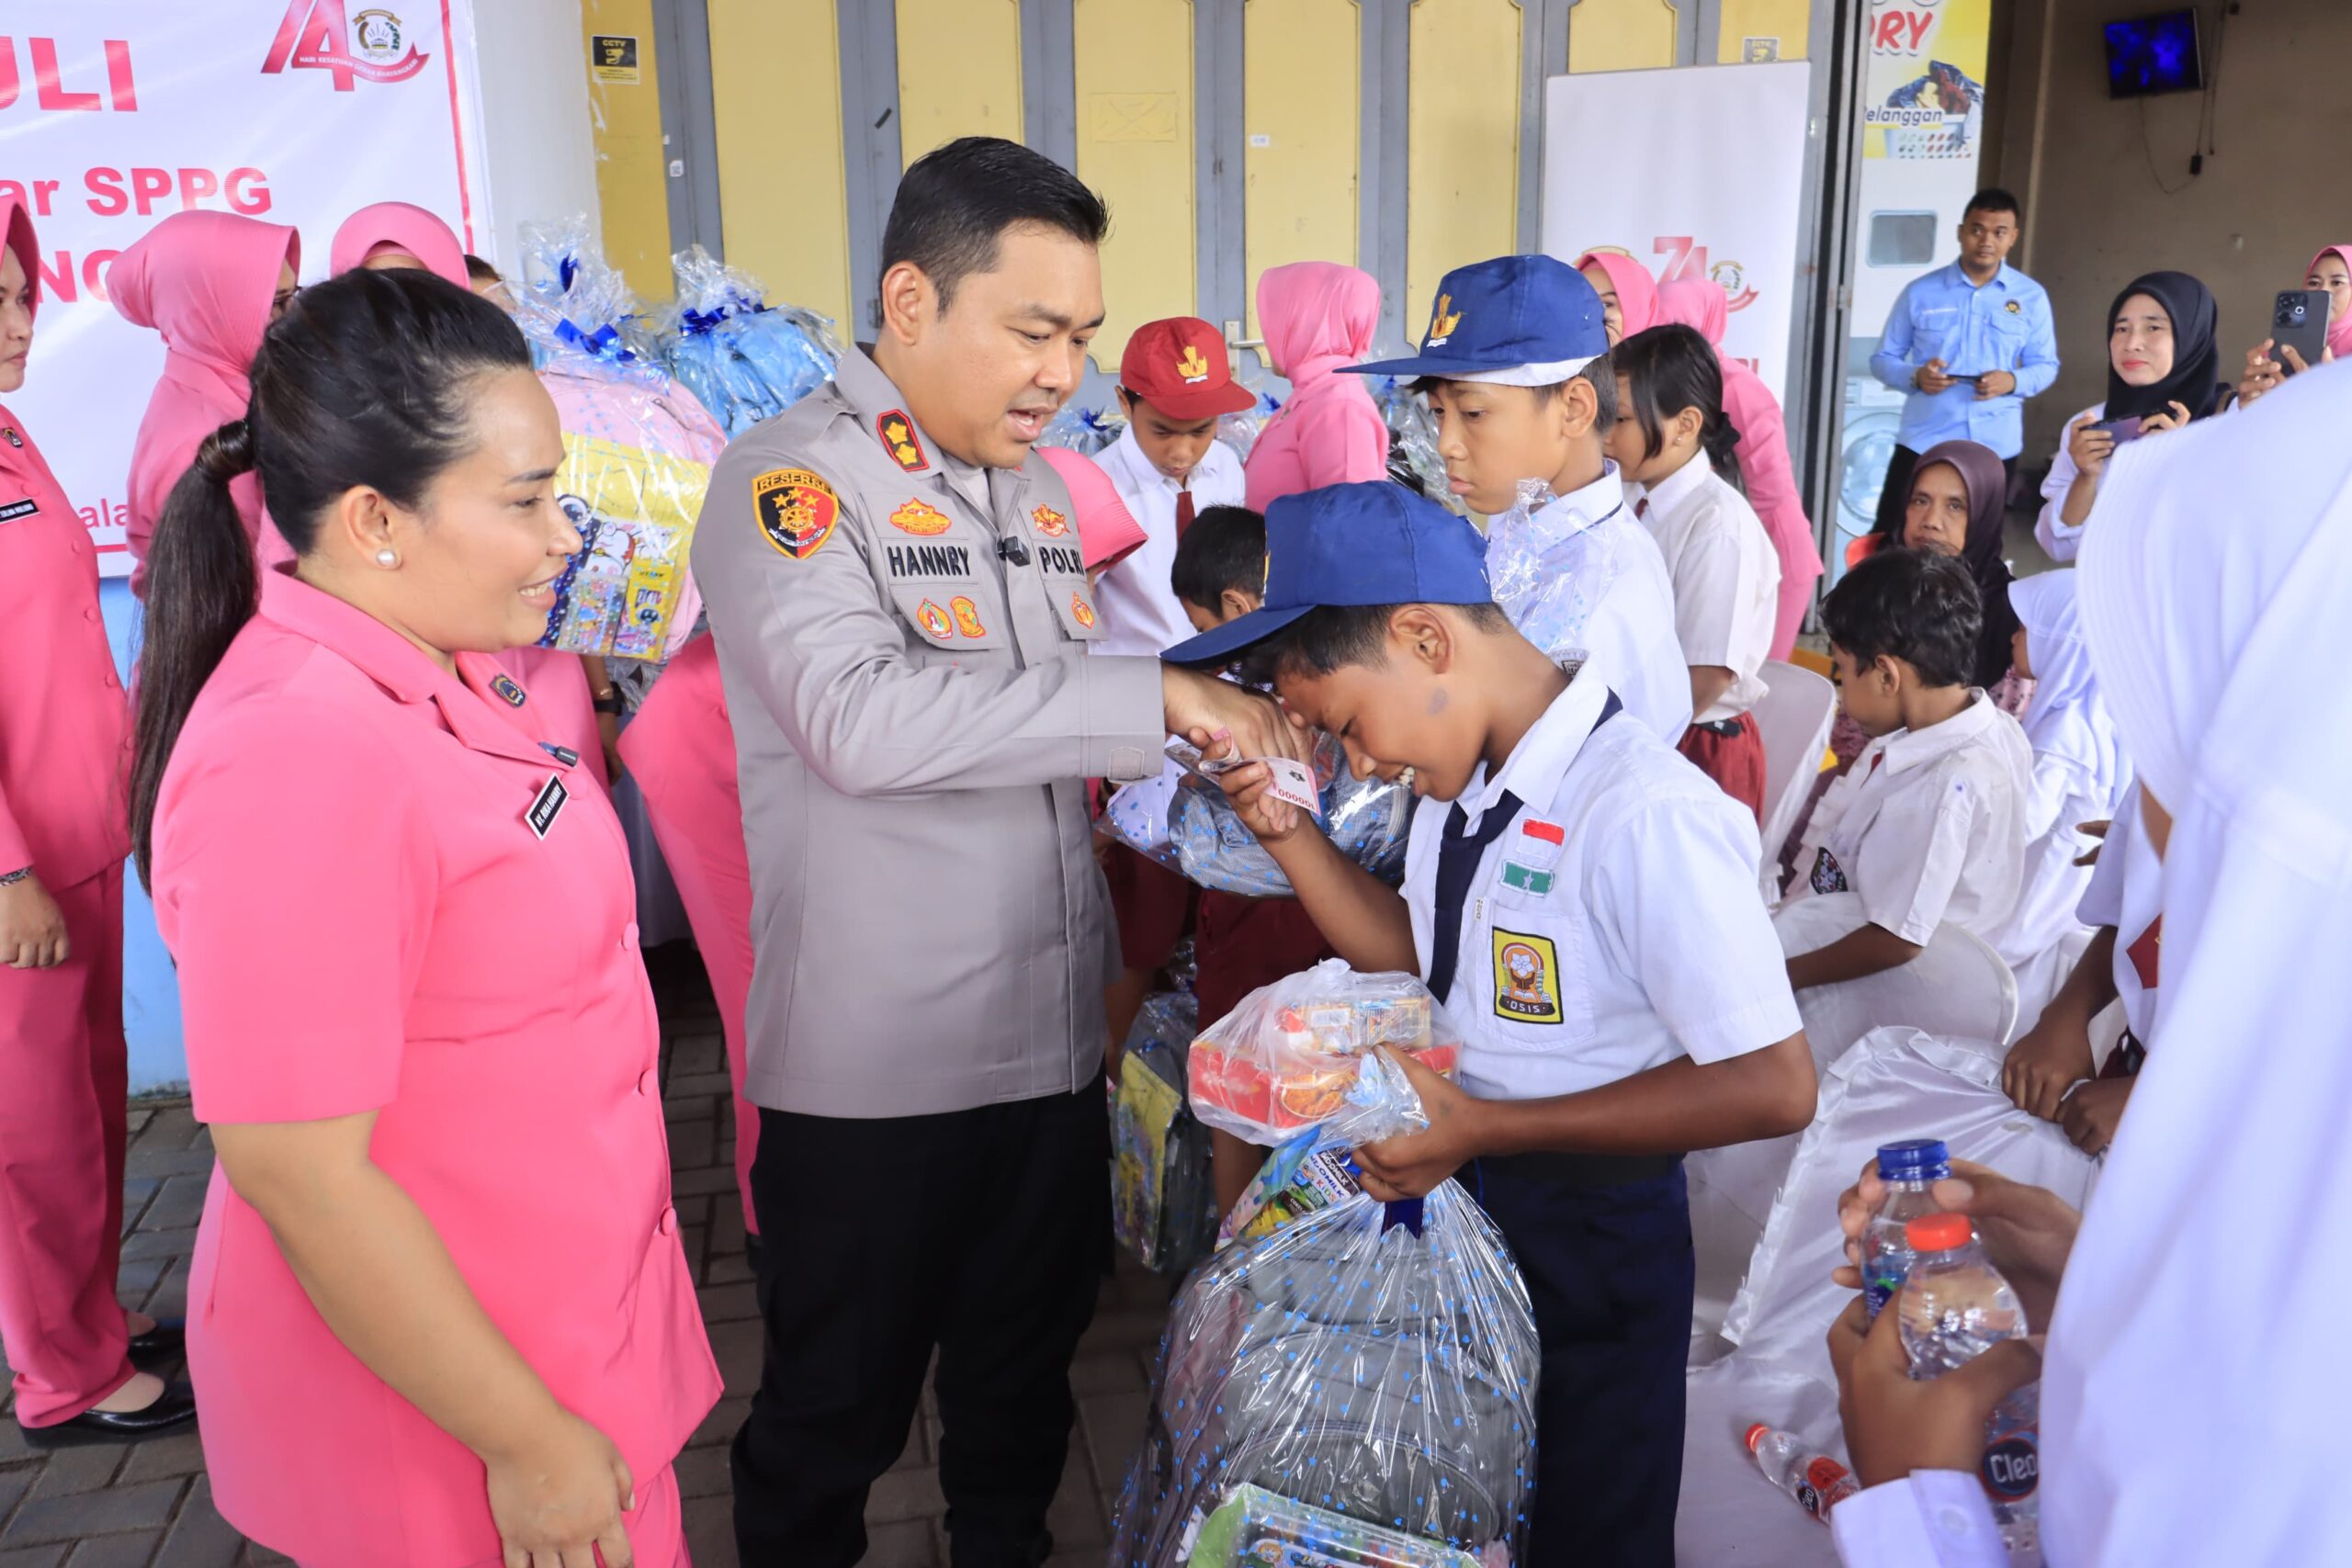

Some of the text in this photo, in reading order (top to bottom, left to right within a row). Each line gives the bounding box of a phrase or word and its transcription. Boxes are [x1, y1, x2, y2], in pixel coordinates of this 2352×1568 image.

[1870, 11, 1933, 50] RY
[0, 36, 138, 112] LI
[1865, 106, 1943, 126] elanggan
[84, 166, 272, 216] SPPG
[887, 546, 971, 577] HANNRY
[1038, 546, 1086, 576] POLRI
[1510, 1000, 1542, 1013] OSIS
[1989, 1453, 2037, 1483] Cleo
